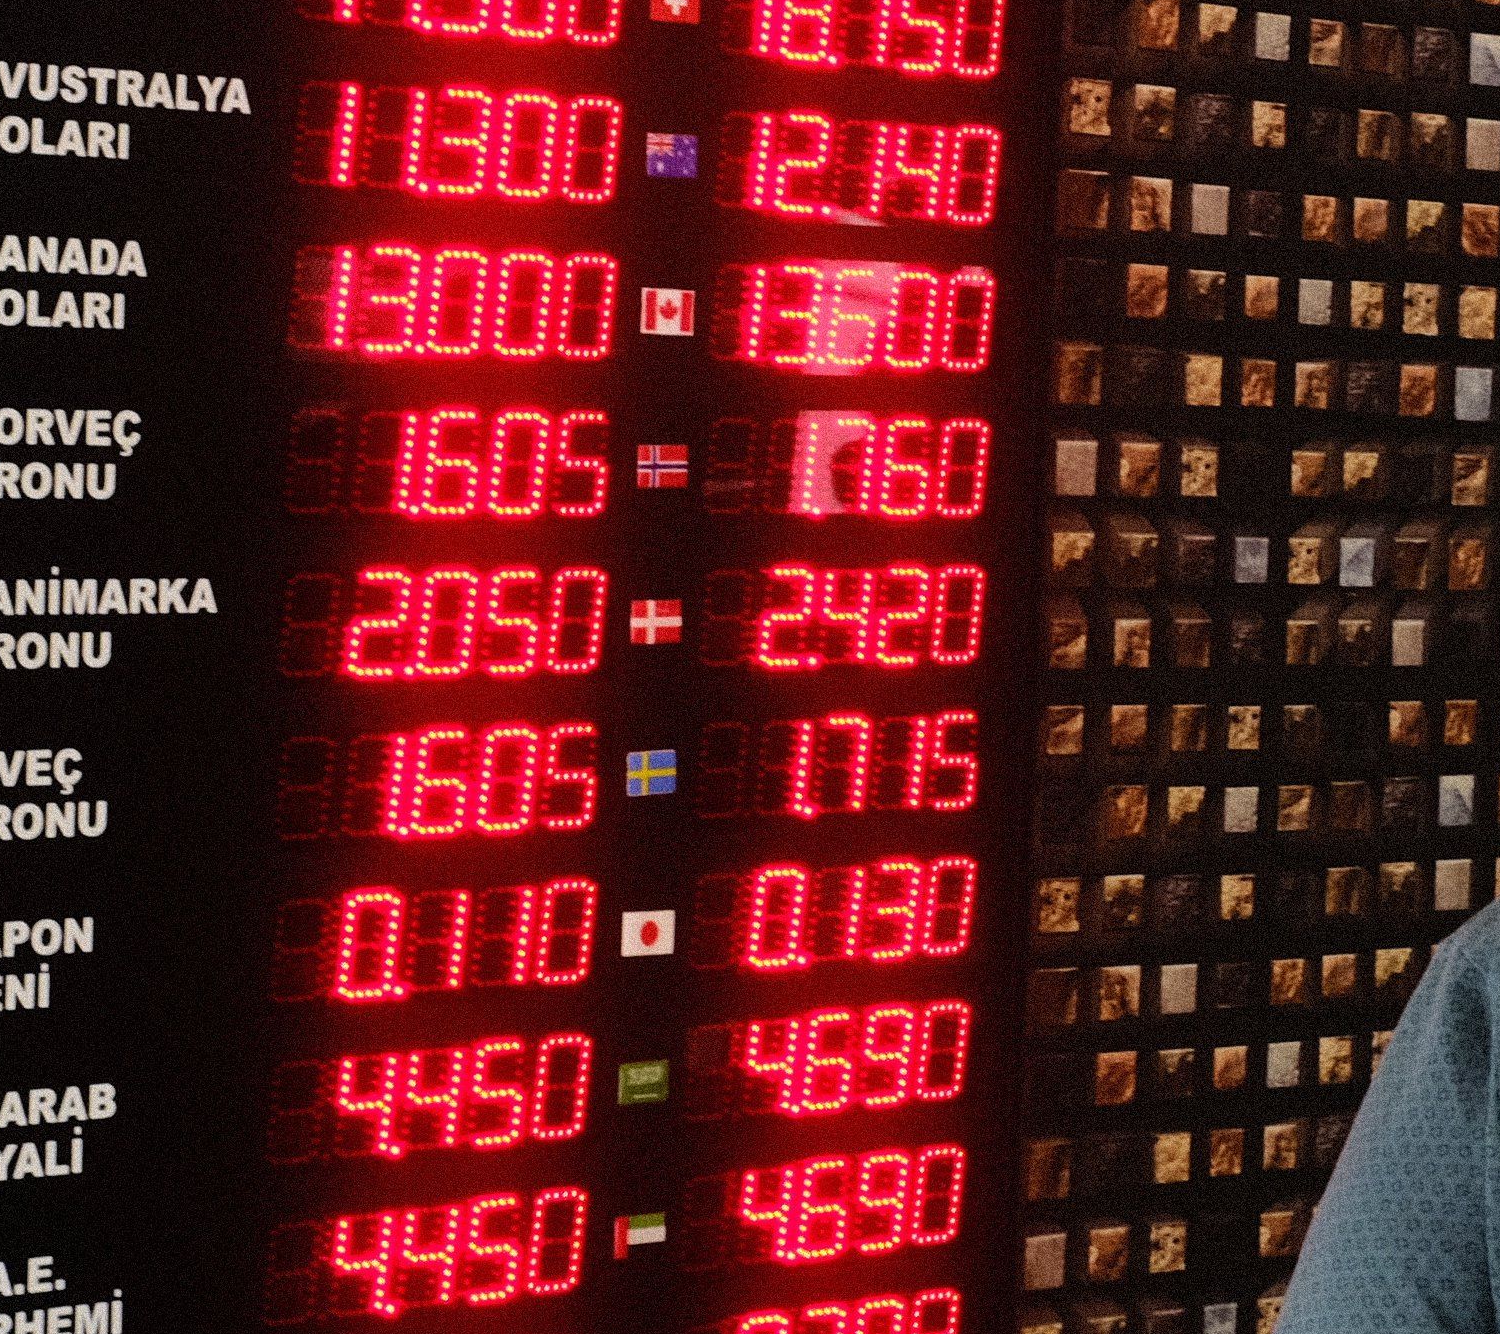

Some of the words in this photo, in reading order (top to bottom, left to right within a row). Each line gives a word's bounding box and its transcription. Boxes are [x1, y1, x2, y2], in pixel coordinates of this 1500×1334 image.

[333, 83, 622, 203] 11.300
[750, 109, 1000, 227] 12.140
[330, 245, 617, 362] 13.000
[743, 263, 996, 374] 13.600
[397, 410, 609, 518] 1.605
[800, 417, 990, 520] 1.760
[346, 566, 607, 678] 2.050
[758, 562, 985, 669] 2.420
[387, 724, 597, 836] 1.605
[793, 712, 978, 819] 1.715
[336, 878, 597, 1001] 0.110
[748, 857, 978, 970] 0.130
[338, 1034, 593, 1157] 4.450
[748, 1001, 970, 1116] 4.690
[334, 1188, 587, 1315] 4.450
[743, 1145, 965, 1262] 4.690
